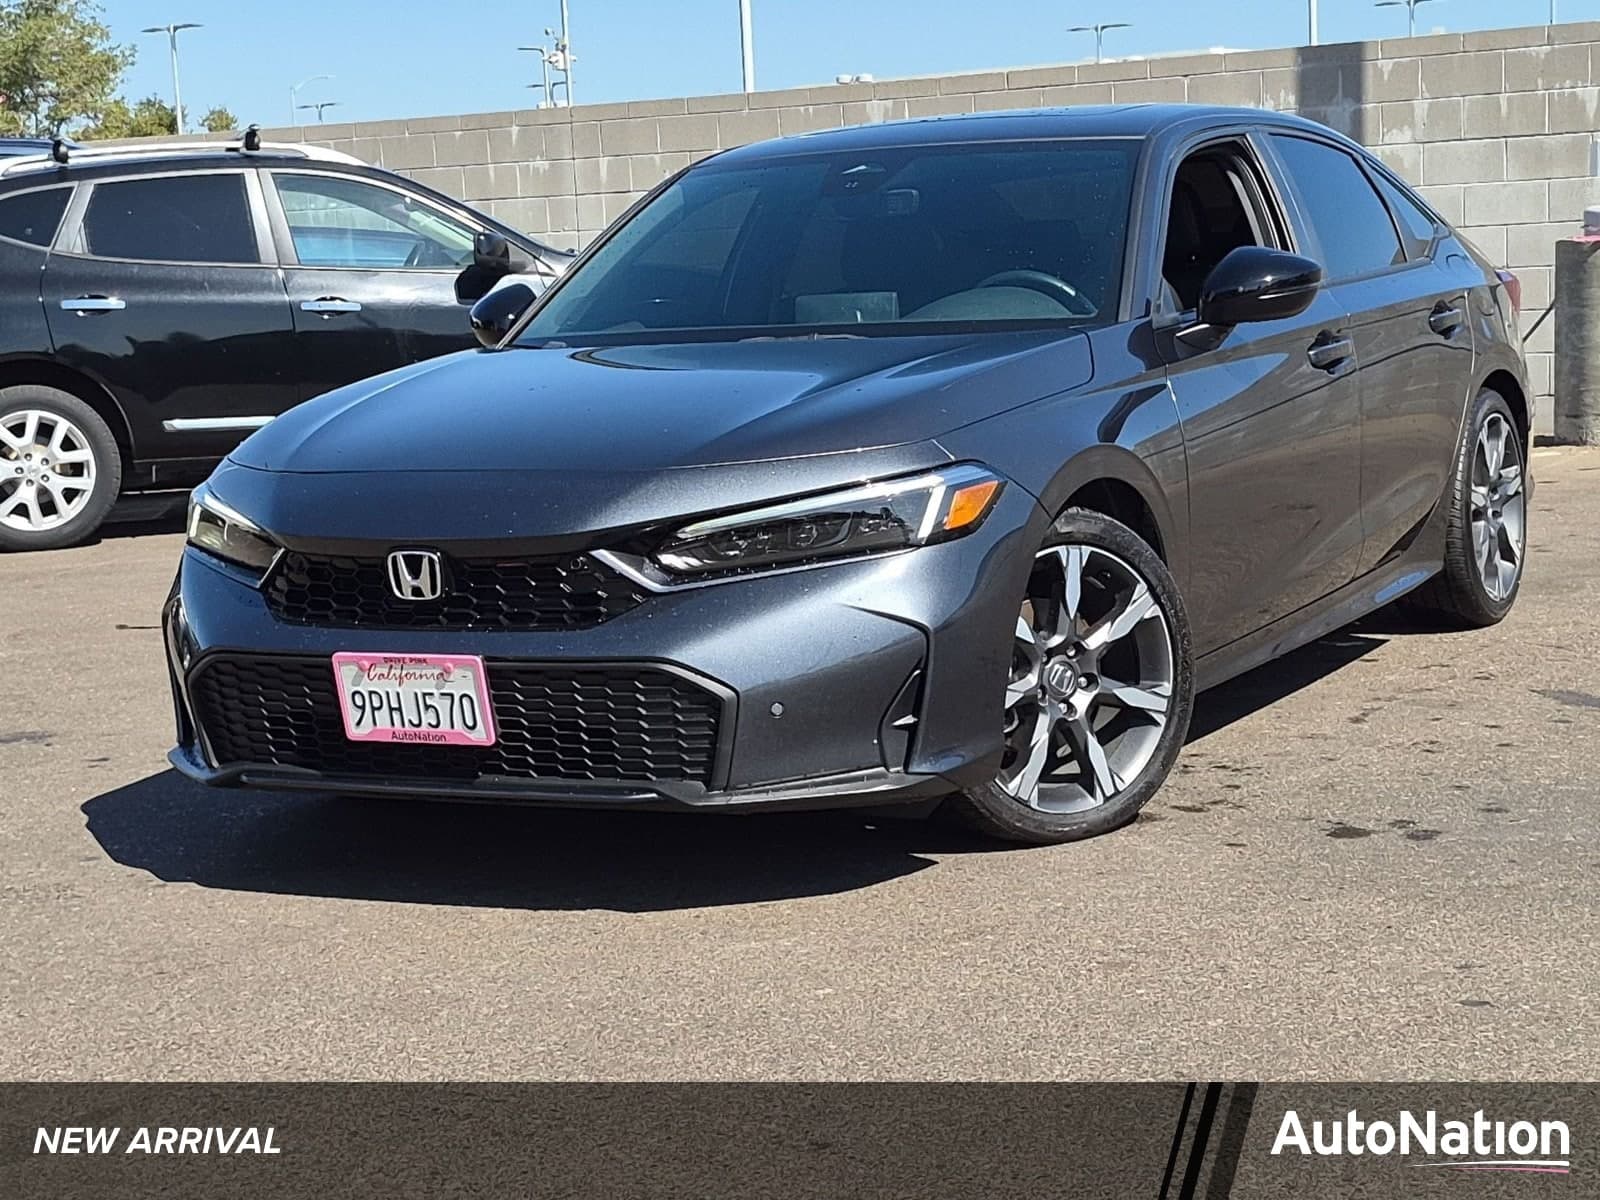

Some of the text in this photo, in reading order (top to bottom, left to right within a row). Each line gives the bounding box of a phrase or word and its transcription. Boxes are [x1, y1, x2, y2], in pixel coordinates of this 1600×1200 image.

[366, 663, 456, 688] California
[351, 690, 478, 731] 9PHJ570
[390, 730, 447, 743] AutoNation
